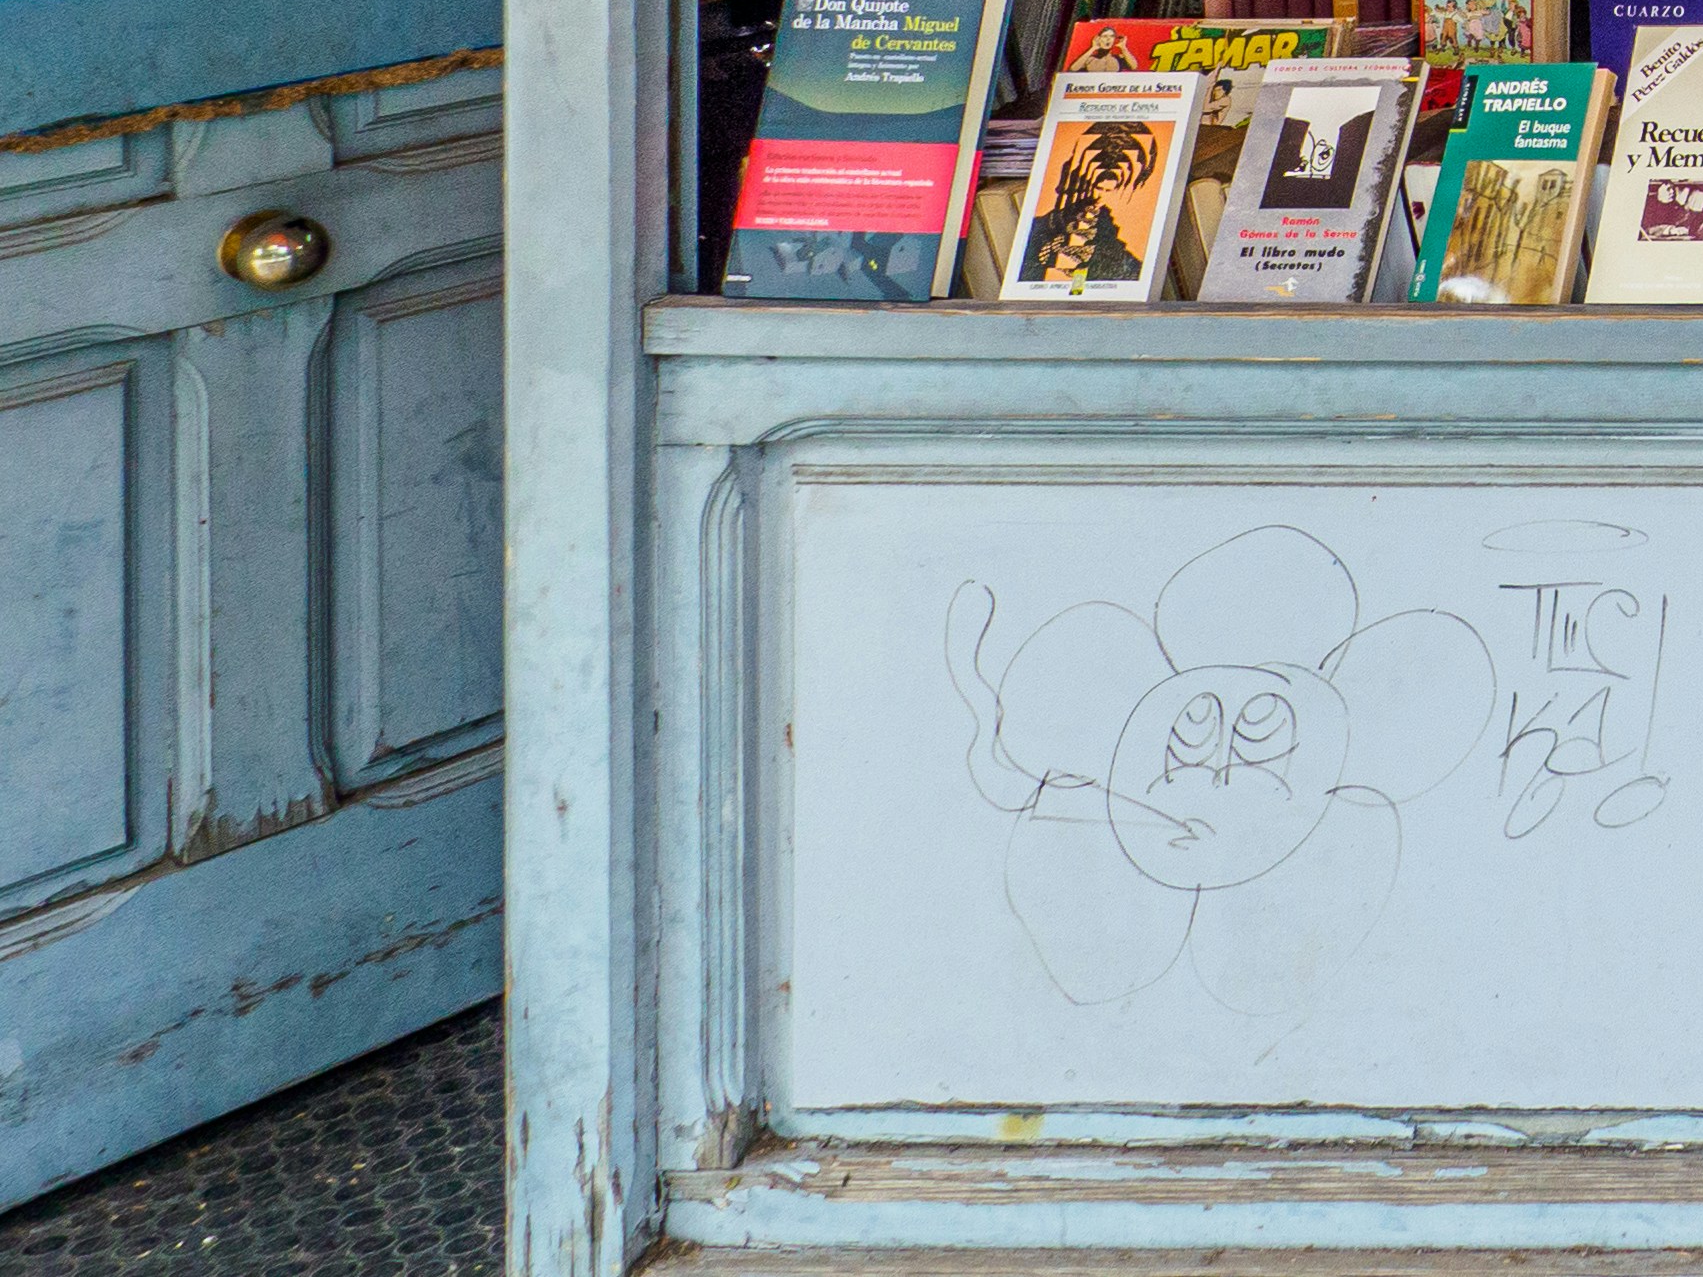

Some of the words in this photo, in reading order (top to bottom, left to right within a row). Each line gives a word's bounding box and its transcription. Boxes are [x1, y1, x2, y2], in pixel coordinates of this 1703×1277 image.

[1613, 3, 1685, 18] CUARZO
[851, 34, 871, 50] de
[875, 36, 957, 52] Cervantes
[1151, 32, 1301, 71] TAMAR
[1639, 40, 1683, 80] Benito
[1483, 77, 1549, 96] ANDRÉS
[1482, 97, 1568, 113] TRAPIELLO
[1518, 120, 1532, 133] El
[1535, 120, 1571, 137] buque
[1514, 134, 1569, 150] fantasma
[1627, 154, 1639, 173] y
[1239, 246, 1256, 258] El
[1261, 246, 1298, 259] libro
[1304, 247, 1346, 259] mudo
